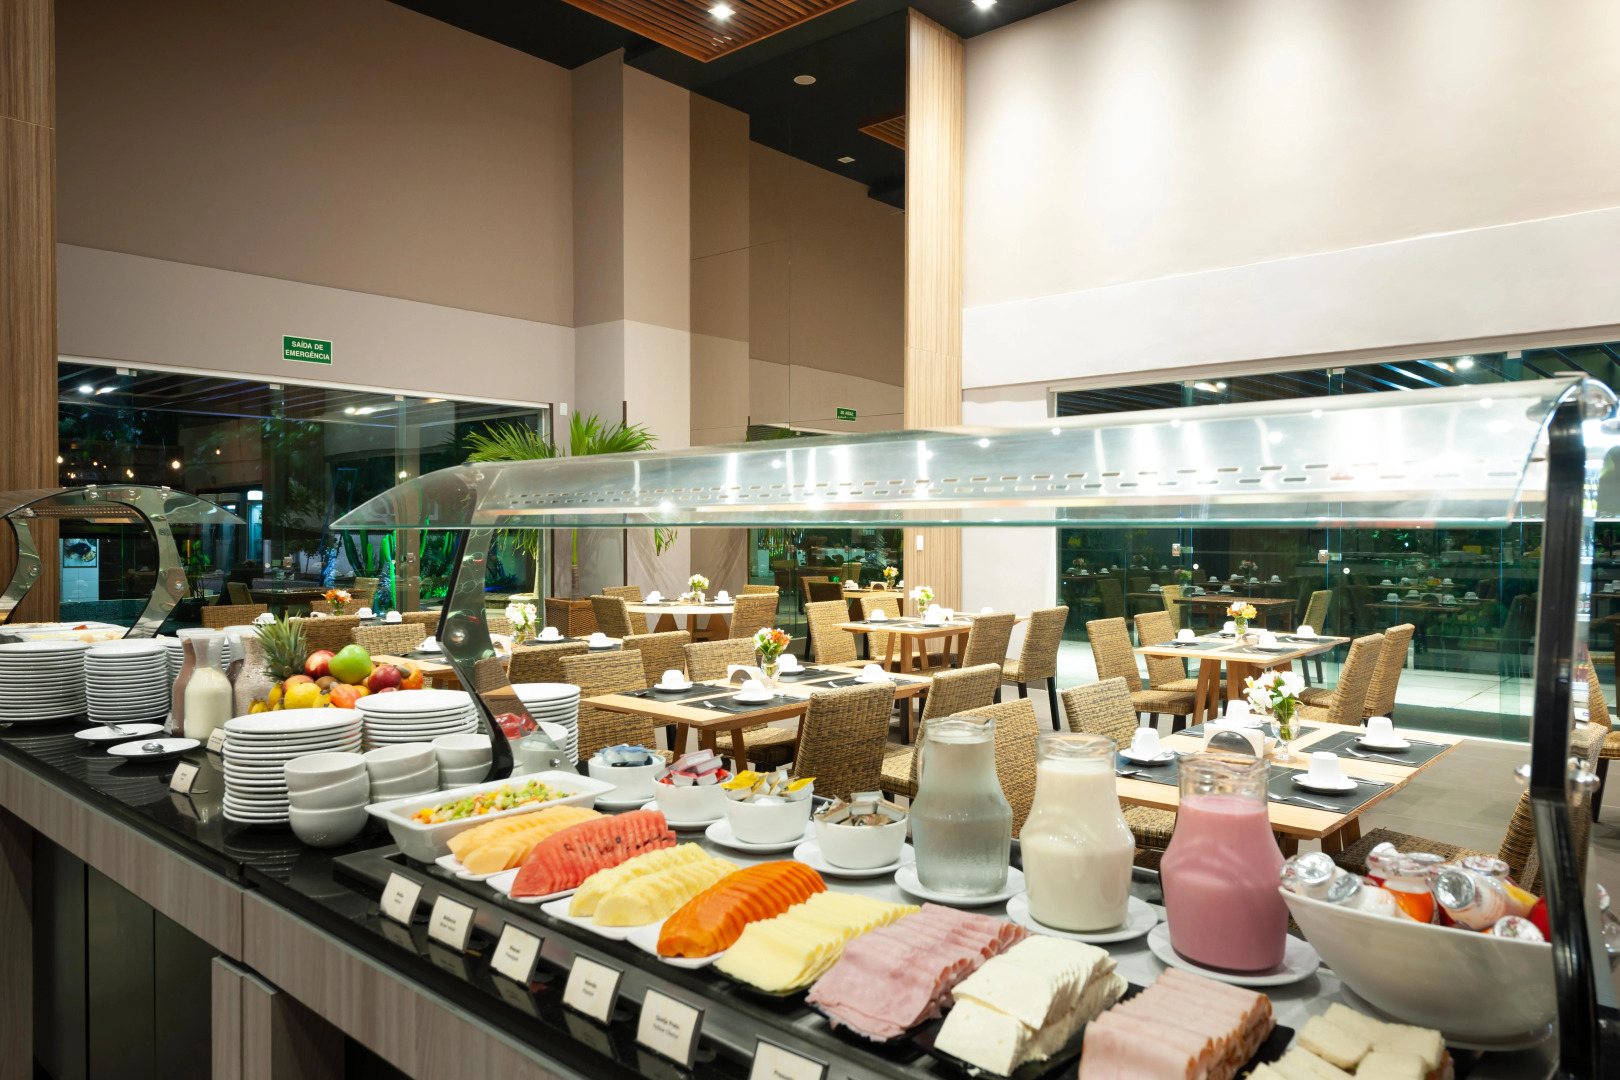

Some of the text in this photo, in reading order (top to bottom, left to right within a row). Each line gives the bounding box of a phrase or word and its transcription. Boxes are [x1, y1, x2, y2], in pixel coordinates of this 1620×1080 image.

[291, 340, 324, 351] SAÍDA DE
[285, 349, 330, 360] EMERGÊNCIA
